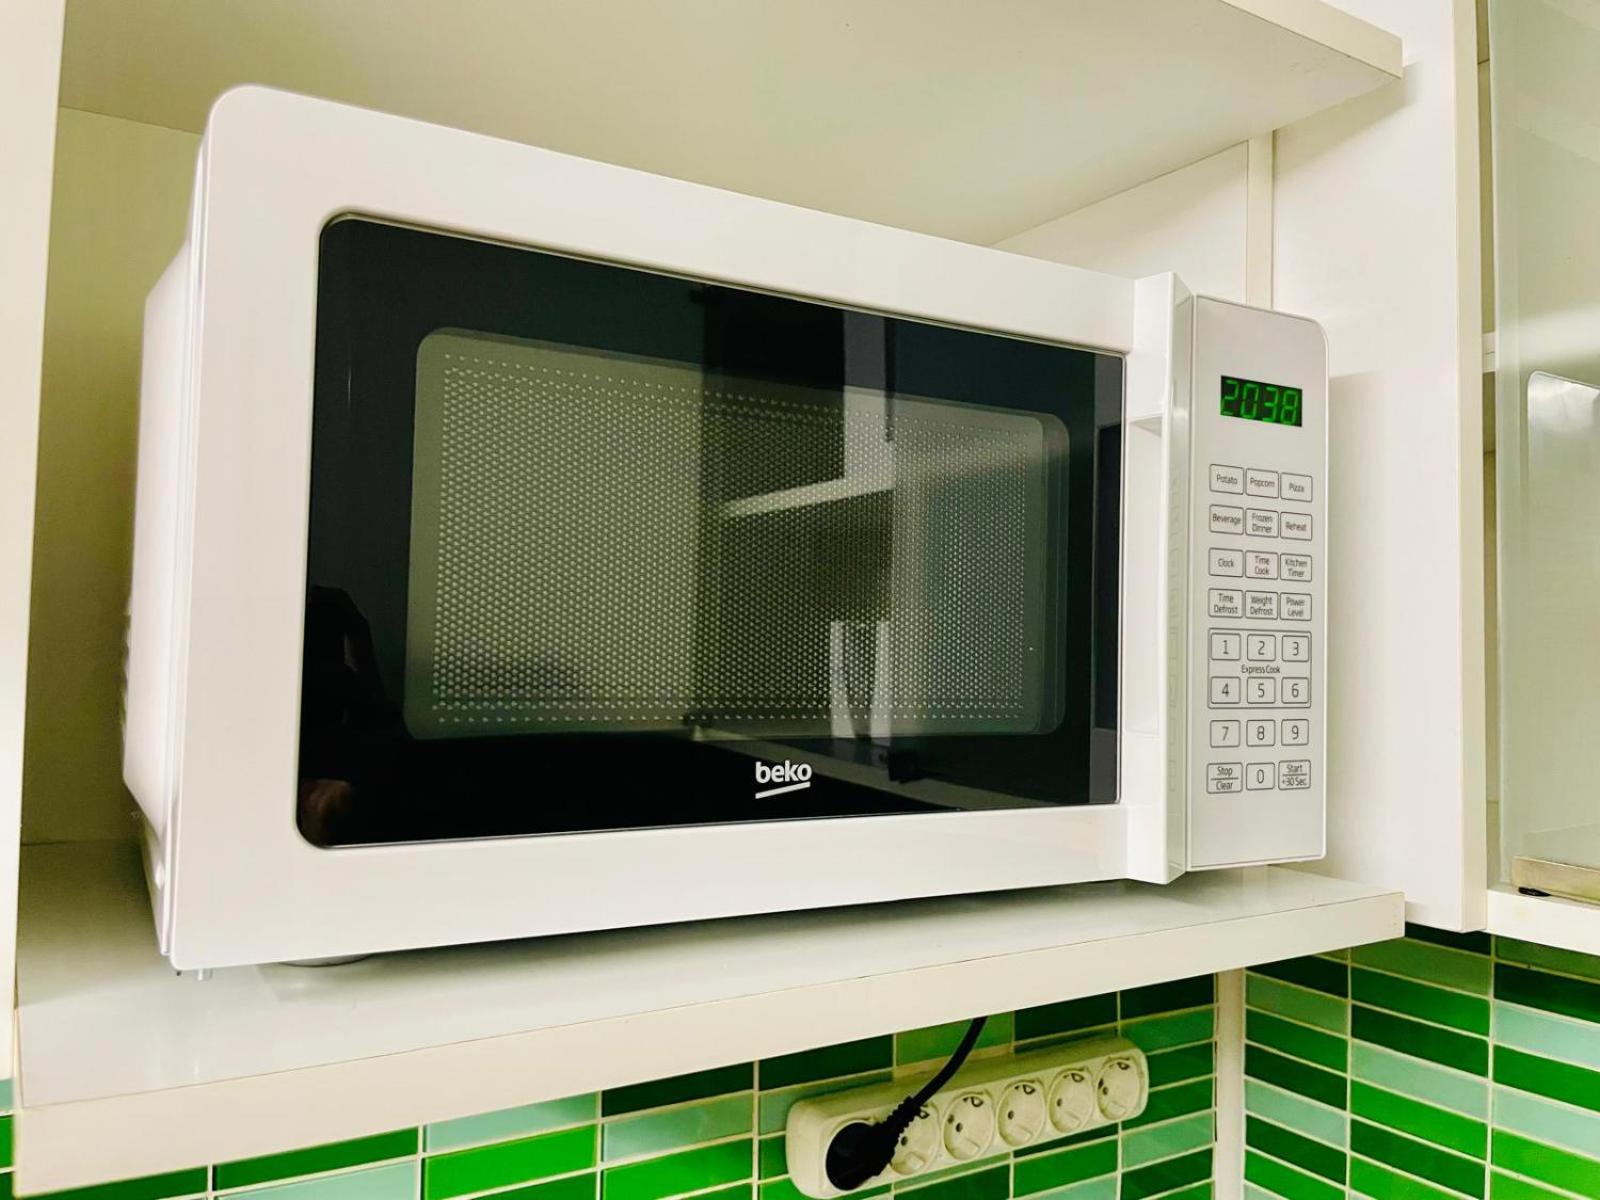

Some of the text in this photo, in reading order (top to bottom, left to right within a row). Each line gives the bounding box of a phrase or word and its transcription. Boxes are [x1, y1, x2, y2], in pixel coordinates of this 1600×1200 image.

[1220, 379, 1299, 426] 2038
[1216, 474, 1238, 485] Potato
[1250, 477, 1275, 489] Popcorn
[1288, 483, 1304, 493] Pizza
[1212, 513, 1241, 526] Beverage
[1251, 513, 1273, 523] Frozen
[1251, 523, 1272, 534] Dinner
[1285, 521, 1307, 532] Reheat
[1218, 558, 1235, 568] Clock
[1254, 555, 1270, 565] Time
[1285, 558, 1307, 567] Kitchen
[1254, 566, 1269, 575] Cook
[1287, 568, 1304, 577] Timer
[1218, 593, 1234, 603] Time
[1250, 595, 1272, 607] Weight
[1286, 597, 1305, 606] Power
[1213, 604, 1238, 614] Defrost
[1250, 606, 1273, 616] Defrost
[1287, 608, 1303, 617] Level
[1222, 639, 1229, 655] 1
[1257, 640, 1265, 656] 2
[1291, 641, 1299, 656] 3
[1241, 664, 1281, 674] Express Cook
[1221, 682, 1229, 697] 4
[1257, 682, 1265, 698] 5
[1291, 683, 1299, 698] 6
[1221, 726, 1229, 741] 7
[1256, 725, 1265, 741] 8
[1291, 724, 1299, 740] 9
[755, 760, 812, 784] beko
[1216, 766, 1233, 777] Stop
[1286, 763, 1303, 773] Start
[1256, 769, 1265, 784] 0
[1295, 776, 1307, 786] Sec
[1215, 781, 1233, 791] Clear
